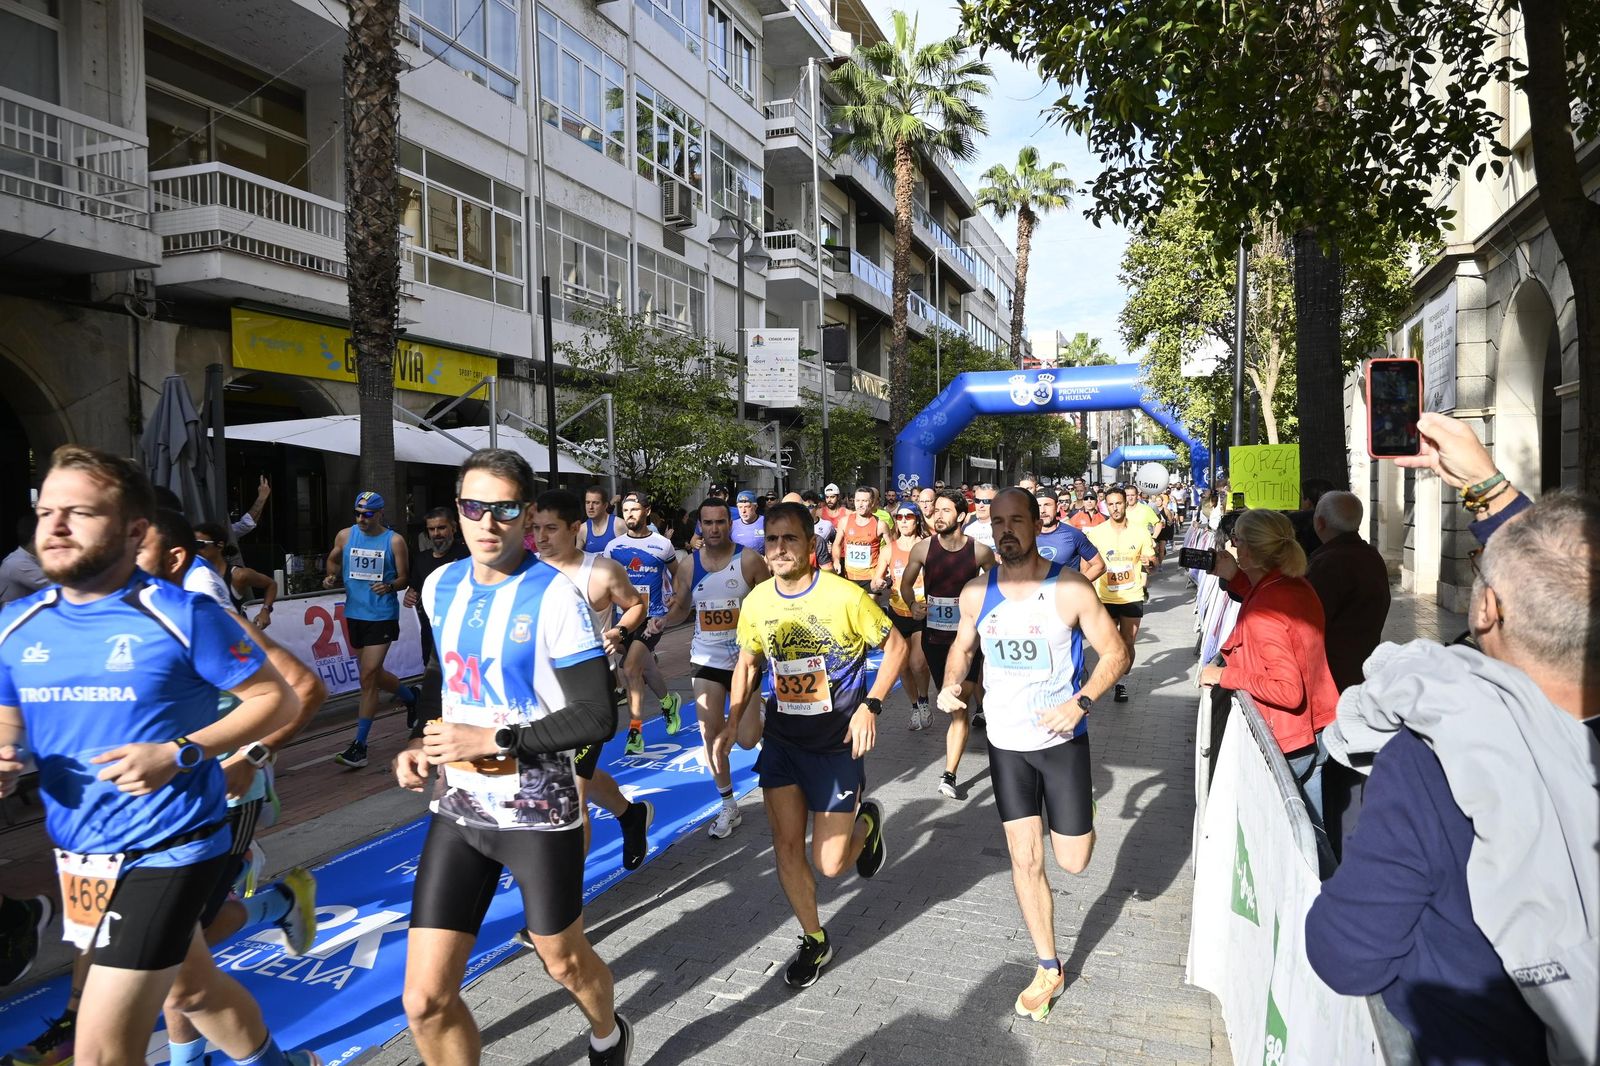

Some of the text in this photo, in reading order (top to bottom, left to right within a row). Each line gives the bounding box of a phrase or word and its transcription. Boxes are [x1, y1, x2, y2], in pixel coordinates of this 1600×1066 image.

[397, 343, 424, 384] VÍA
[1058, 387, 1100, 396] PROVINCIAL
[1232, 448, 1297, 474] FORZA
[354, 556, 377, 570] 191
[850, 551, 867, 560] 125
[1110, 570, 1130, 582] 480
[704, 609, 733, 625] 569
[936, 606, 953, 619] 18
[994, 639, 1038, 661] 139
[315, 655, 345, 667] CIUDAD DE
[317, 660, 360, 686] HUE
[776, 672, 818, 694] 332
[18, 686, 138, 703] TROTASIERRA
[608, 757, 706, 775] HUELVA
[69, 876, 109, 912] 468
[235, 940, 276, 952] CIUDAD
[212, 945, 356, 991] HUELVA
